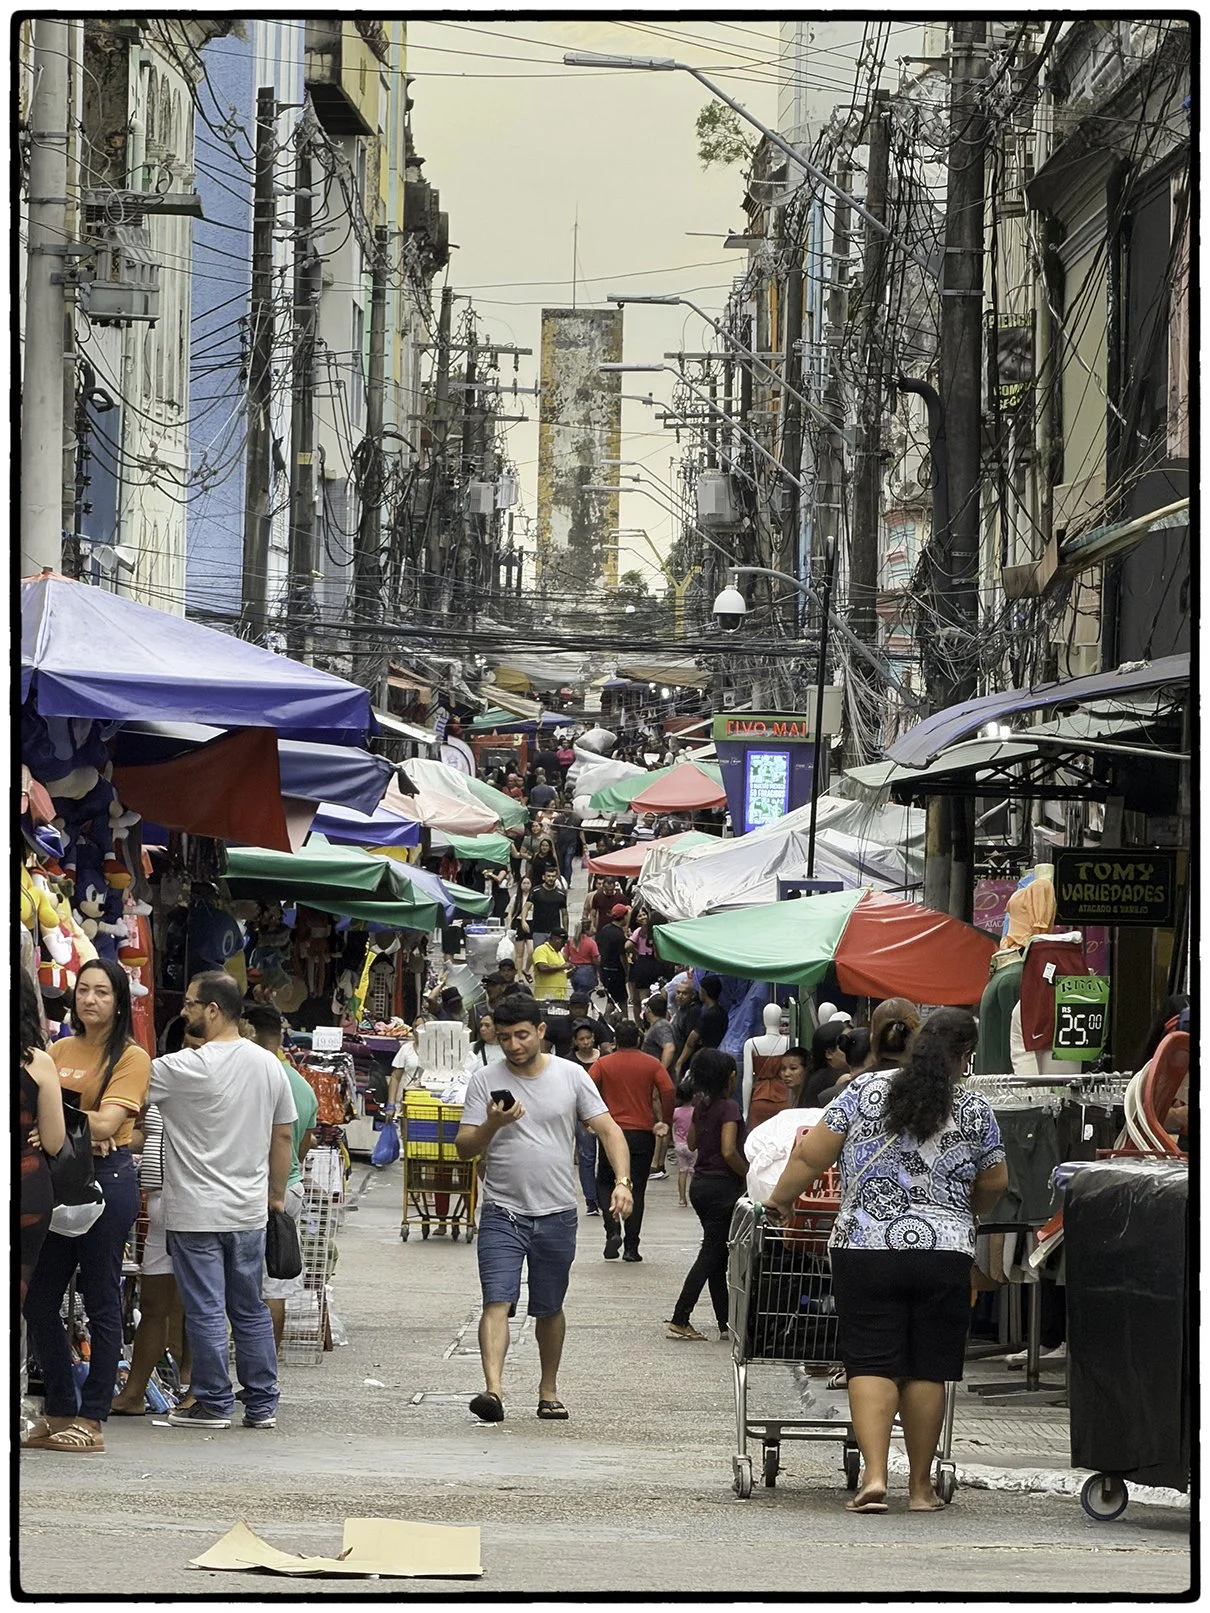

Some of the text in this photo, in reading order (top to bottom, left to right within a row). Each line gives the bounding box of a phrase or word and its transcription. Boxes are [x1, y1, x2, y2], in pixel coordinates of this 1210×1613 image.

[1074, 862, 1154, 880] TOMY
[1061, 883, 1165, 902] VARIEDADES
[1078, 904, 1111, 913] ATACADO
